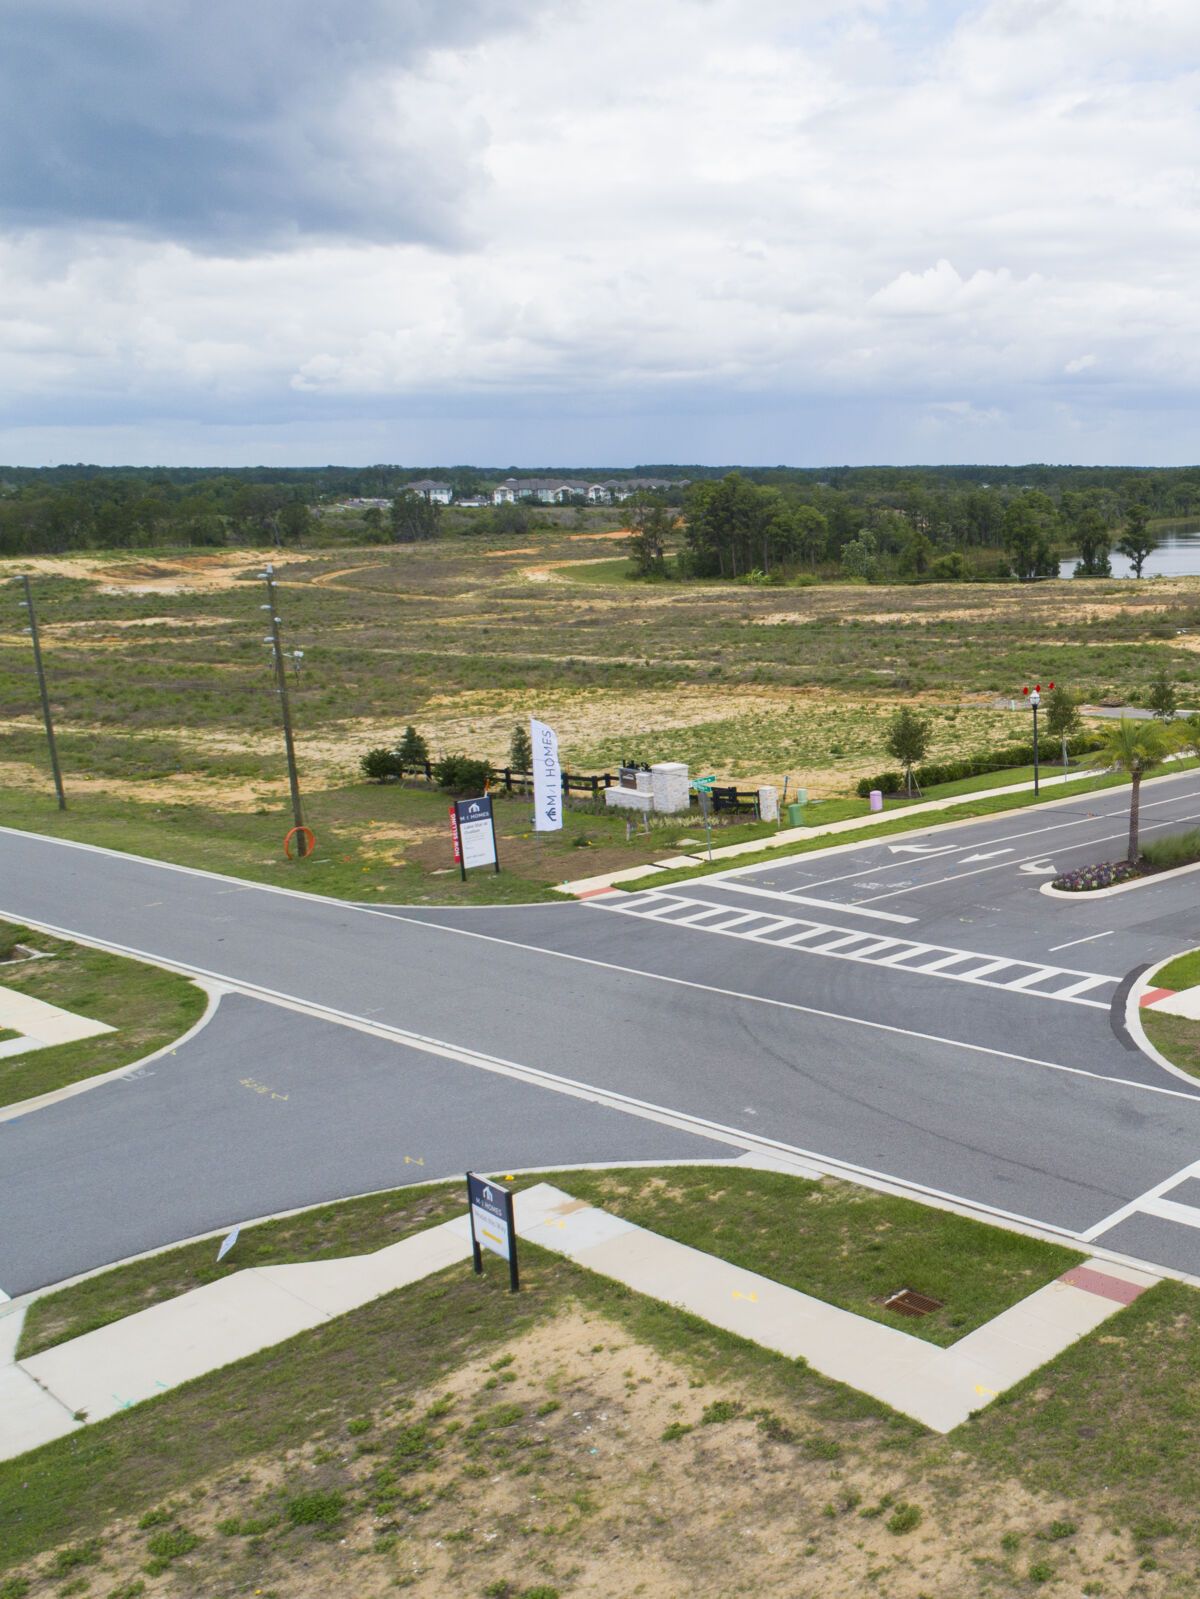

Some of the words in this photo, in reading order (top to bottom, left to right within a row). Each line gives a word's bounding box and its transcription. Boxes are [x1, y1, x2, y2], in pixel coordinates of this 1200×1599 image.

[541, 730, 556, 777] HOMES
[470, 811, 489, 819] HOMES
[451, 813, 459, 840] SELLING
[484, 1202, 503, 1217] HOMES
